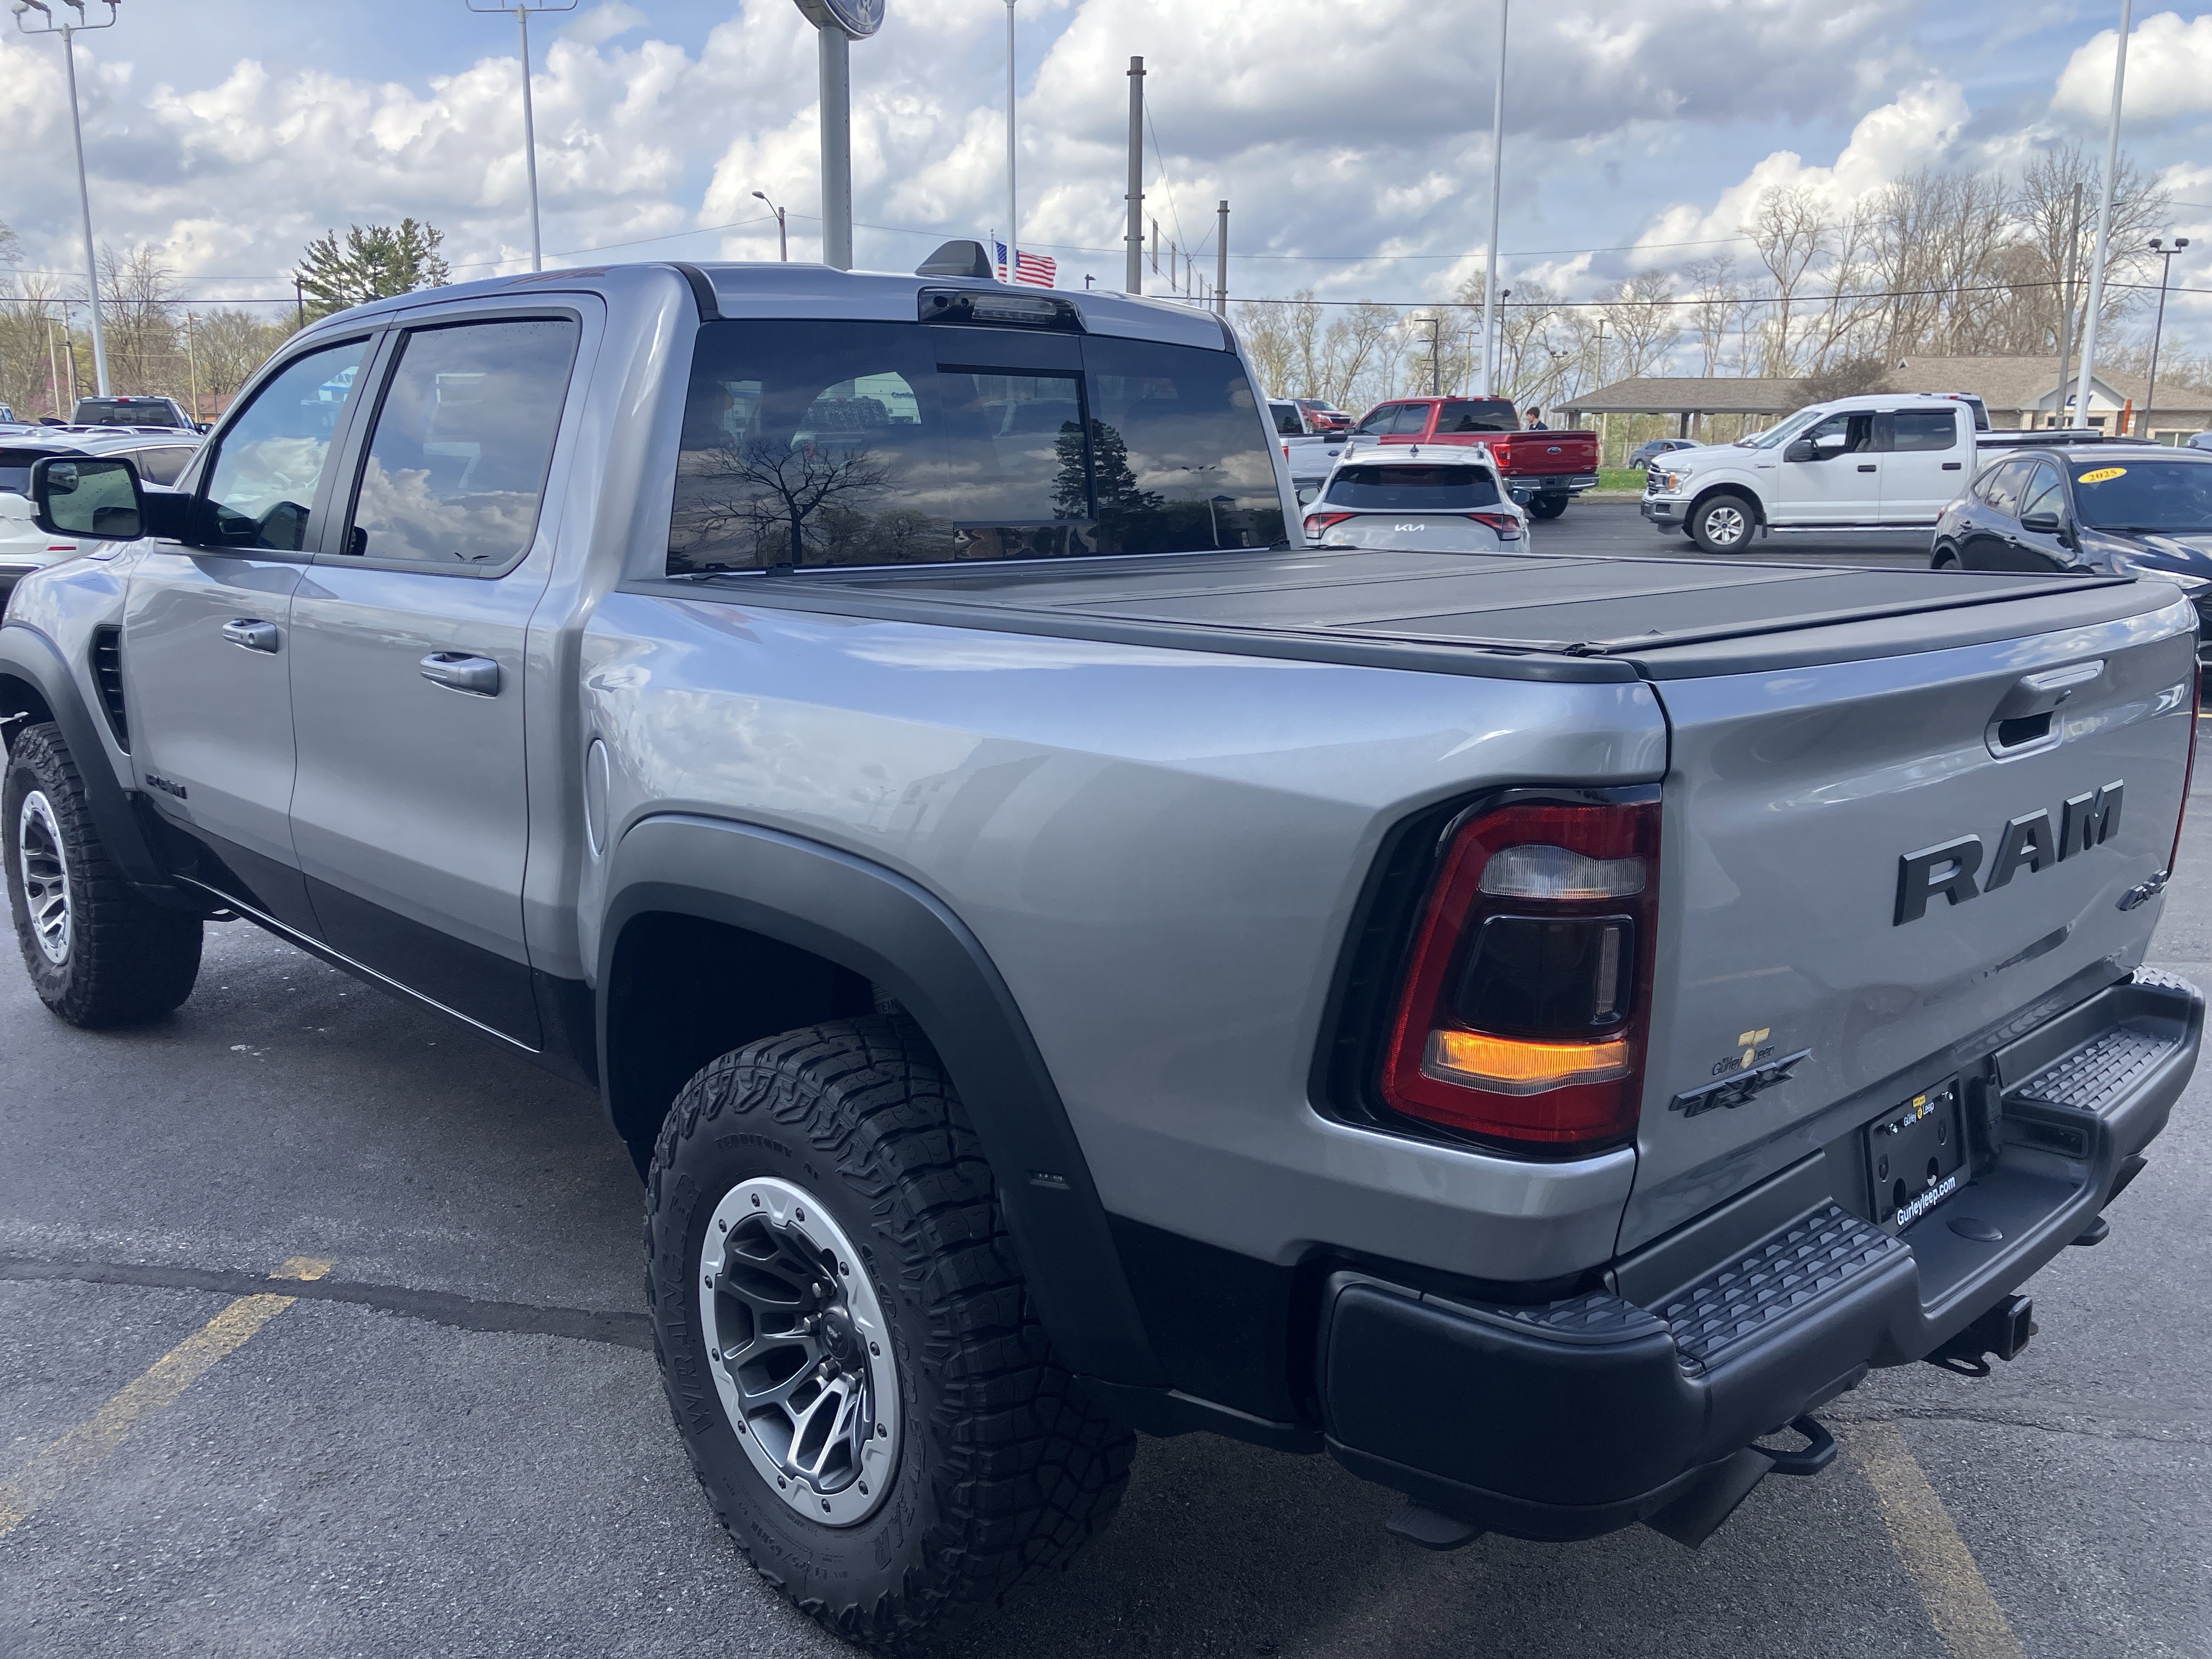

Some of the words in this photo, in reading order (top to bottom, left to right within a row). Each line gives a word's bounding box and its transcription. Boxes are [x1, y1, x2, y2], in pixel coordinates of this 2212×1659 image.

[2089, 469, 2117, 481] 2025
[1893, 778, 2124, 927] RAM
[1753, 1045, 1775, 1062] Leep
[1897, 1176, 1956, 1226] Gurleyleep.com
